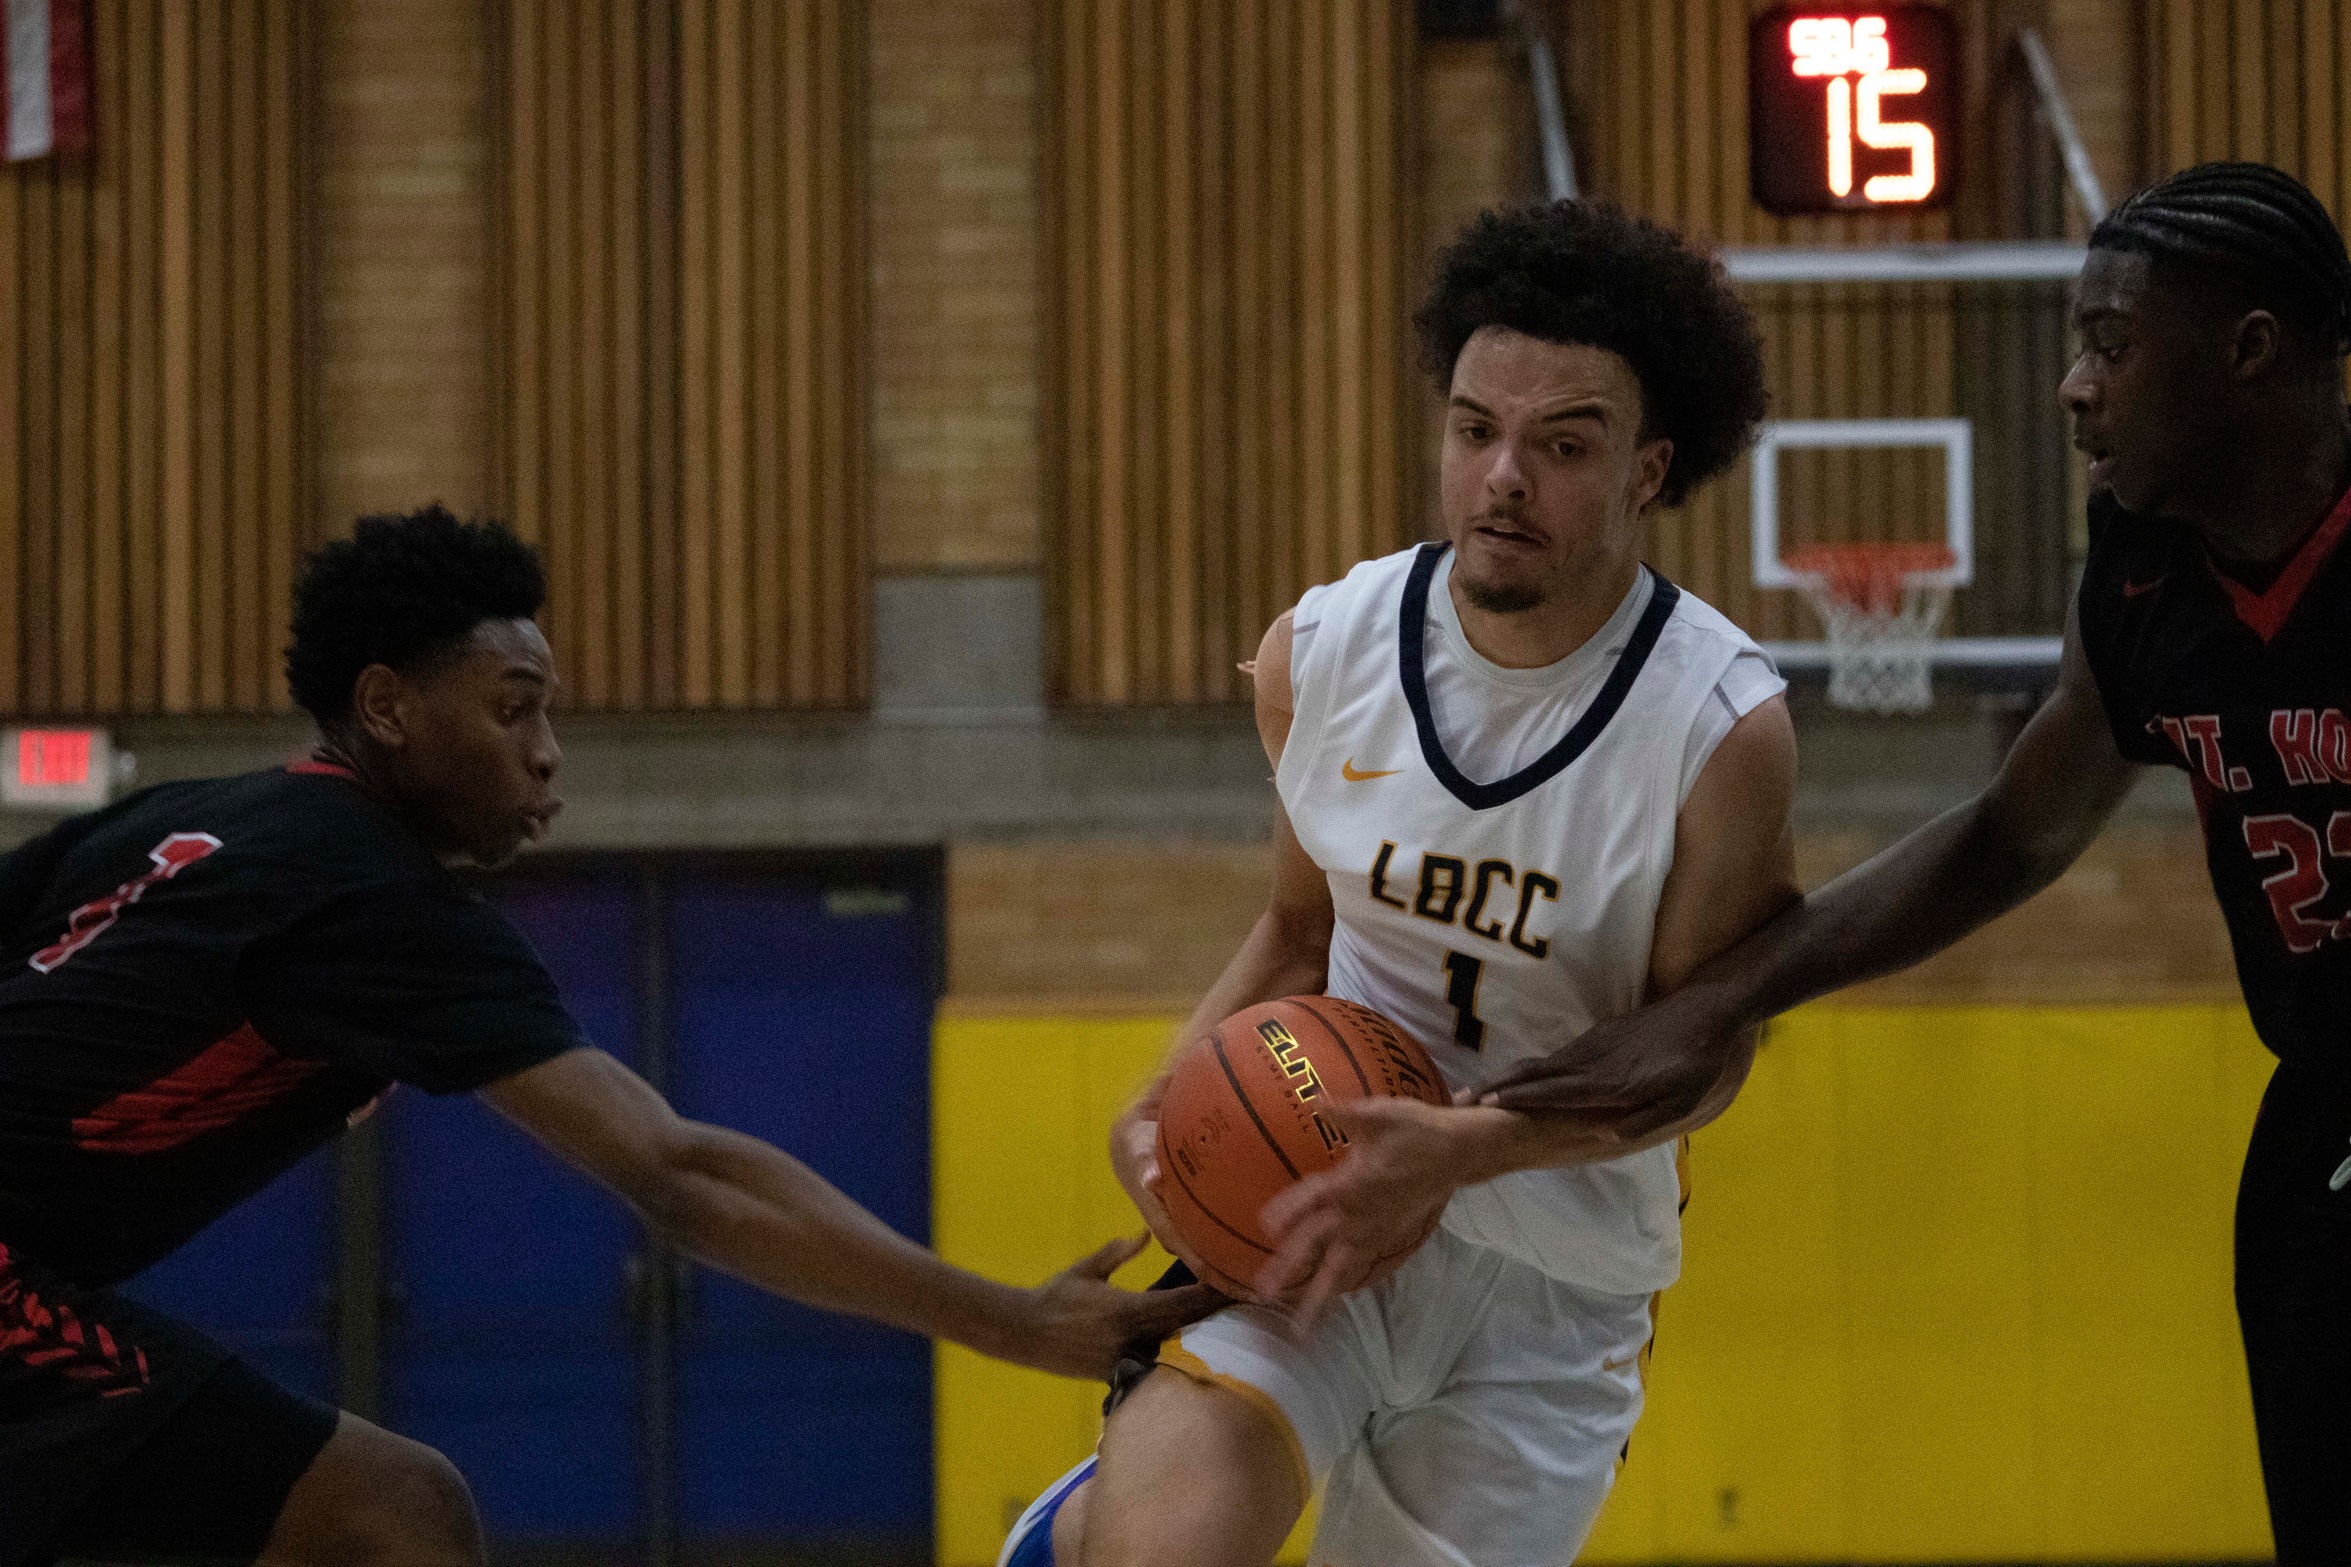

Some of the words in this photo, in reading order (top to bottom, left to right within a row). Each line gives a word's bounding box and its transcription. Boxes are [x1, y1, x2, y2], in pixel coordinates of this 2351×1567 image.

[1827, 68, 1936, 202] 15
[1369, 838, 1562, 960] LBCC
[1443, 949, 1488, 1053] 1
[1284, 1088, 1310, 1135] BALL
